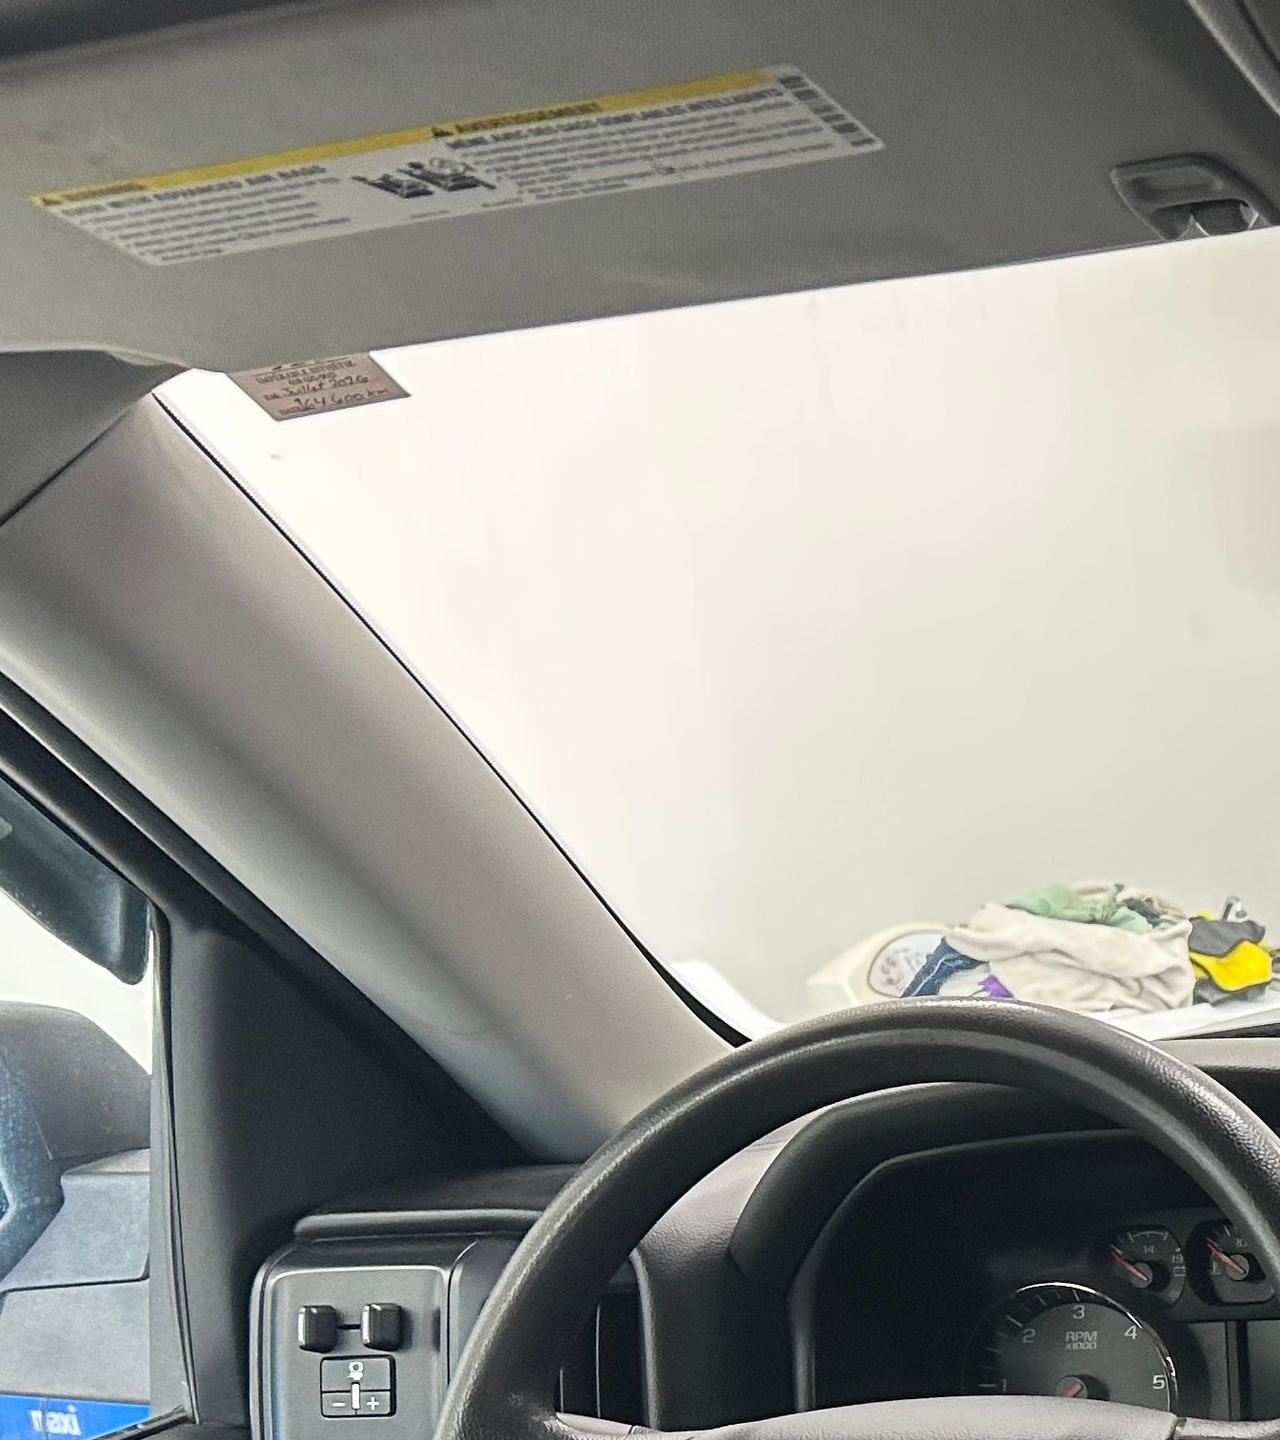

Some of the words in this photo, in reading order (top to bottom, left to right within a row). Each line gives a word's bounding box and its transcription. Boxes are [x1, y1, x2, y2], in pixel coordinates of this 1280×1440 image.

[1072, 1304, 1086, 1320] 3
[1022, 1328, 1036, 1344] 2
[1065, 1331, 1098, 1342] RPM
[1124, 1325, 1138, 1340] 4
[1152, 1374, 1166, 1390] 5
